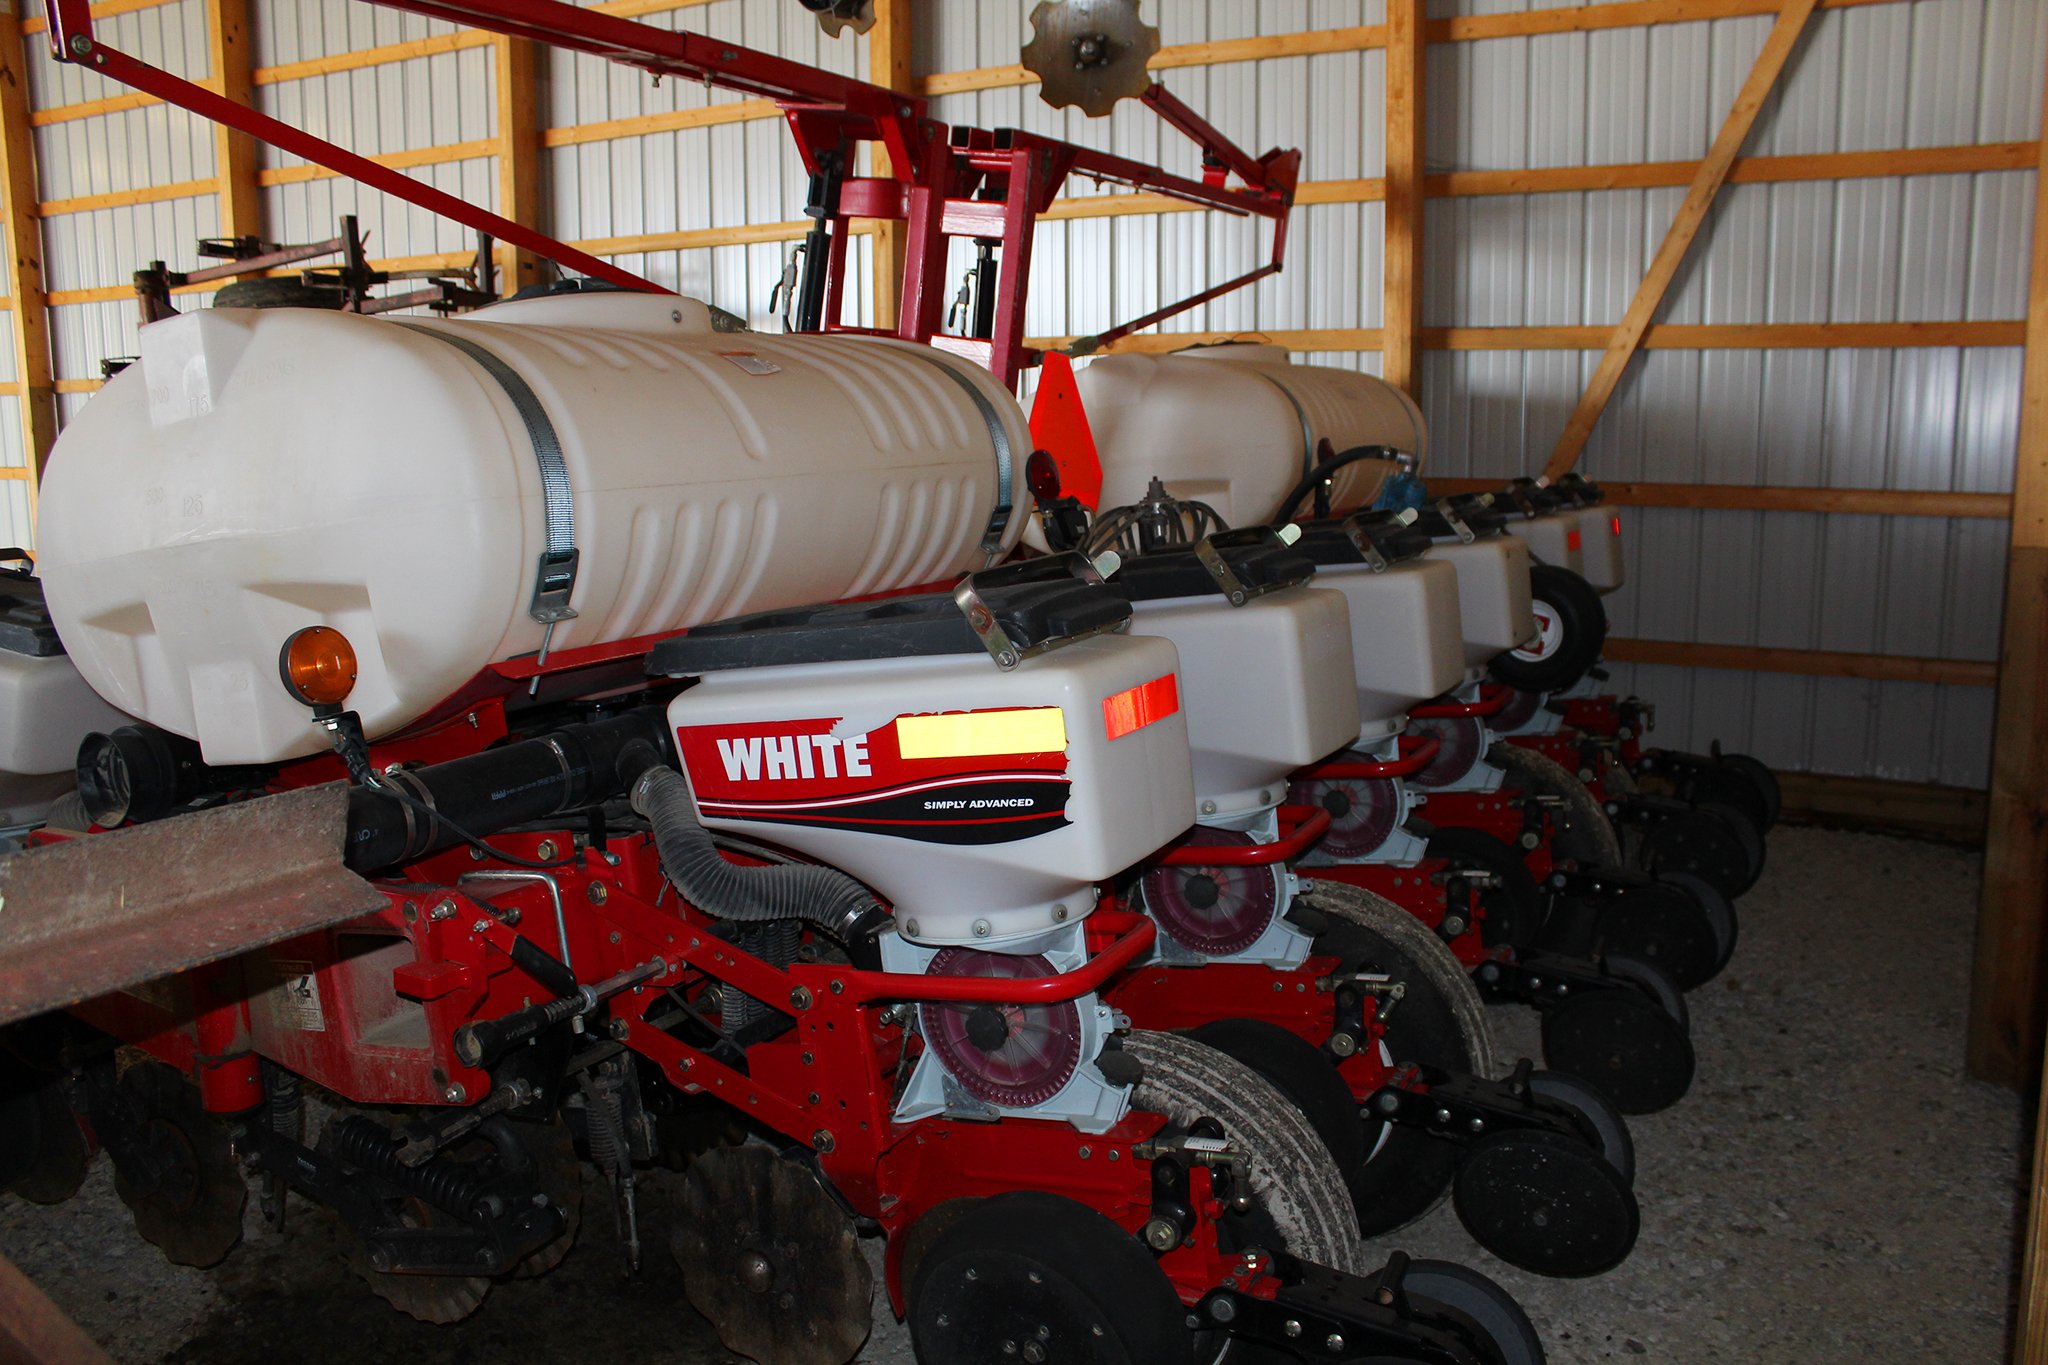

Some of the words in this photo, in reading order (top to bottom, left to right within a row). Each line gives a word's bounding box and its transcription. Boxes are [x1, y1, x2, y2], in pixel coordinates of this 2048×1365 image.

[188, 394, 209, 416] 175
[183, 495, 203, 517] 125
[716, 733, 872, 782] WHITE
[924, 801, 967, 810] SIMPLY
[969, 798, 1034, 808] ADVANCED
